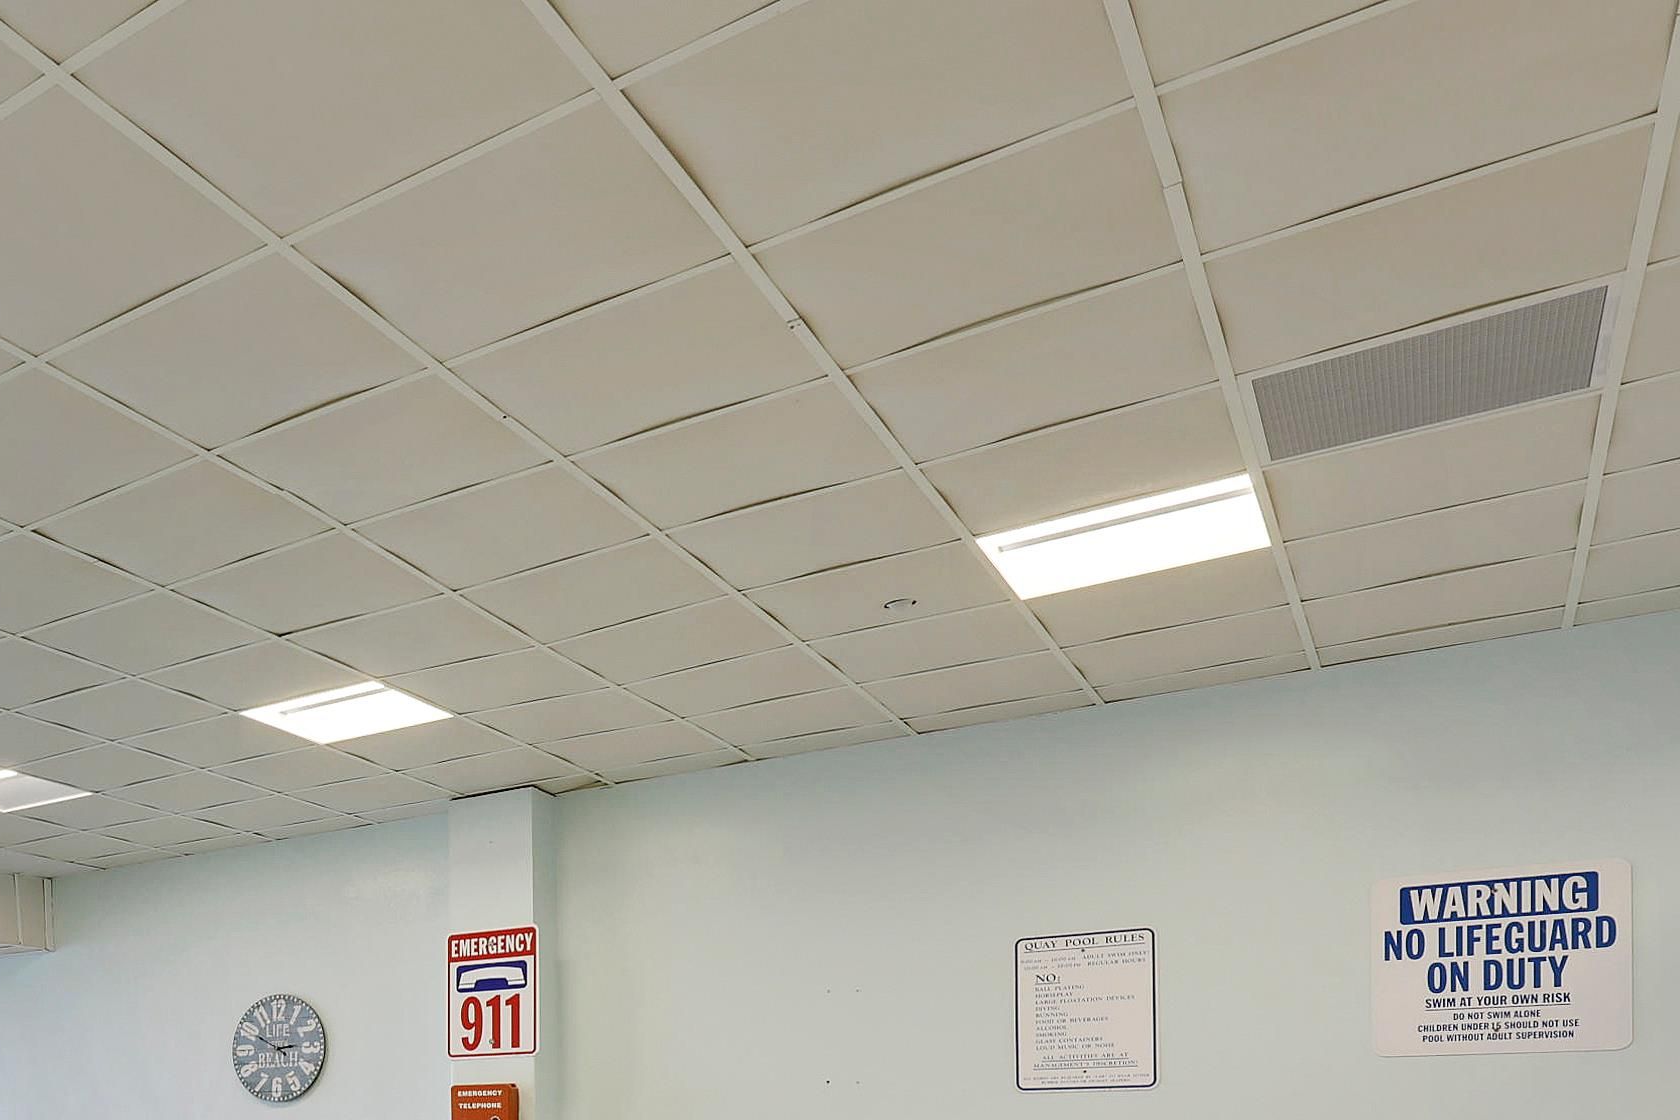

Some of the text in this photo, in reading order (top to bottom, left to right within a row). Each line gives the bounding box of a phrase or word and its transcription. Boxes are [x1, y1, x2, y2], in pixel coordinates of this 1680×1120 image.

[1409, 875, 1589, 922] WARNING
[451, 932, 534, 959] EMERGENCY
[1023, 933, 1146, 951] QUAY POOL RULES
[1384, 915, 1617, 961] NO LIFEGUARD
[1427, 955, 1569, 994] ON DUTY
[1425, 992, 1571, 1009] SWIM AT YOUR OWN RISK
[270, 999, 287, 1021] 12
[1453, 1009, 1541, 1021] DO NOT SWIM ALONE
[266, 1023, 290, 1038] LIFE
[460, 993, 521, 1052] 911
[1417, 1023, 1458, 1033] CHILDREN
[1461, 1022, 1489, 1031] UNDER
[1504, 1020, 1539, 1030] SHOULD
[1542, 1019, 1559, 1028] NOT
[1562, 1018, 1580, 1028] USE
[1422, 1030, 1575, 1043] POOL WITHOUT ADULT SUPERVISION
[301, 1041, 320, 1054] 3
[258, 1051, 299, 1069] BEACH
[271, 1077, 283, 1098] 6
